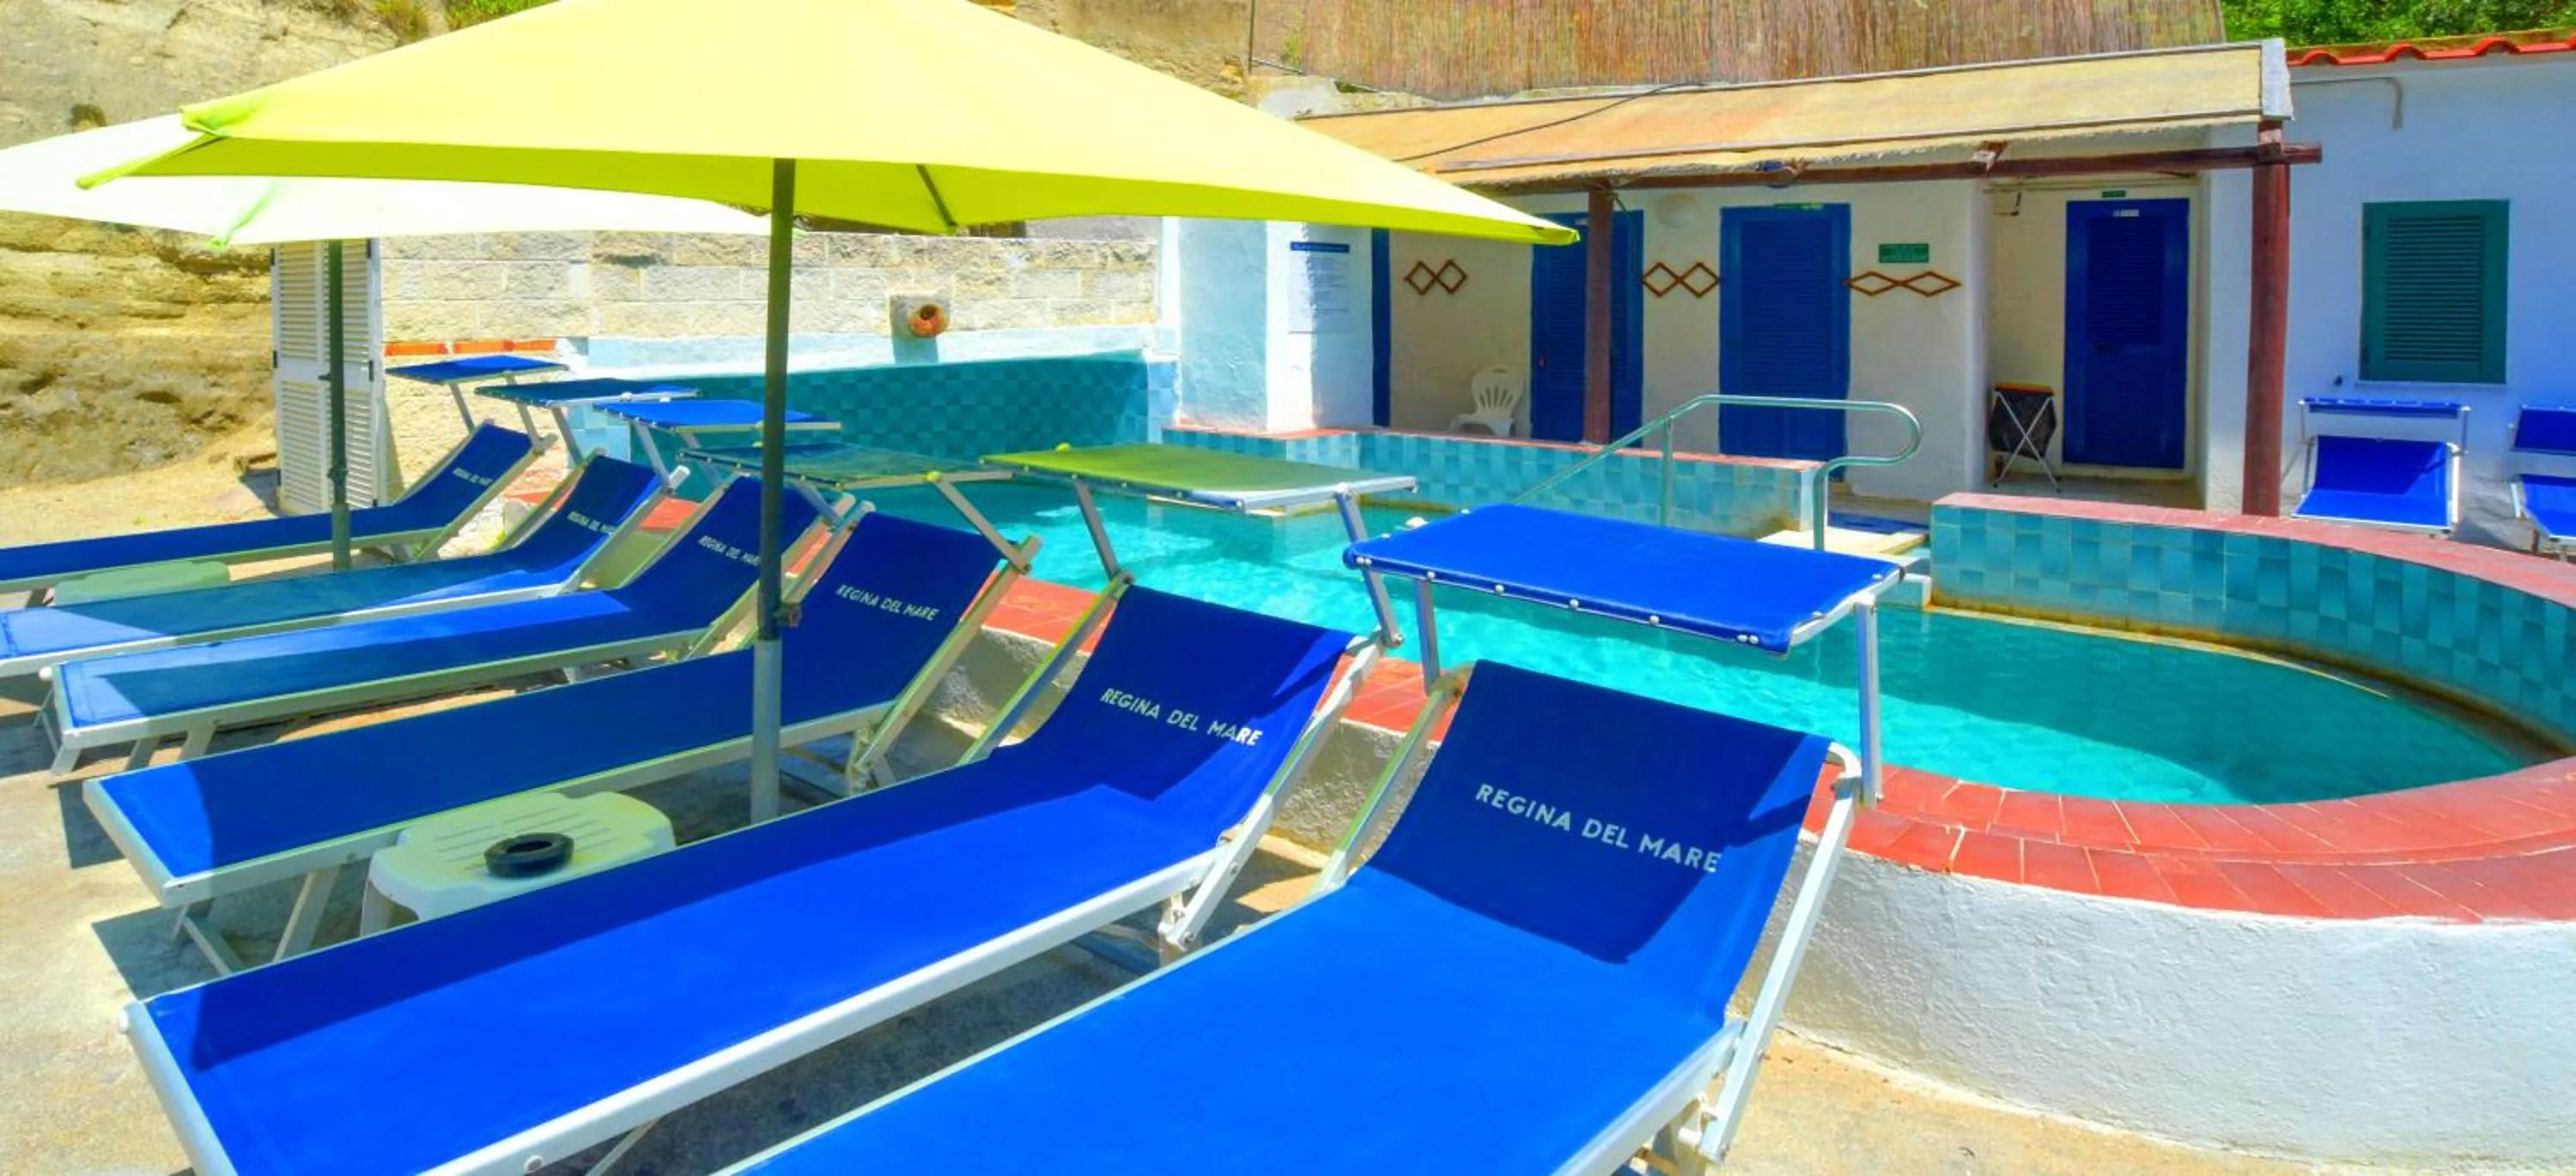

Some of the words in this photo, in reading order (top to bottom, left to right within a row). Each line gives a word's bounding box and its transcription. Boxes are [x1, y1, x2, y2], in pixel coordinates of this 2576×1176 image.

[835, 585, 880, 607] REGINA
[879, 597, 902, 613] DEL
[902, 603, 940, 621] MARE
[1100, 688, 1160, 720] REGINA
[1166, 709, 1200, 731] DEL
[1206, 720, 1264, 746] MARE
[1475, 783, 1571, 831] REGINA
[1581, 818, 1629, 849] DEL
[1638, 834, 1722, 873] MARE
